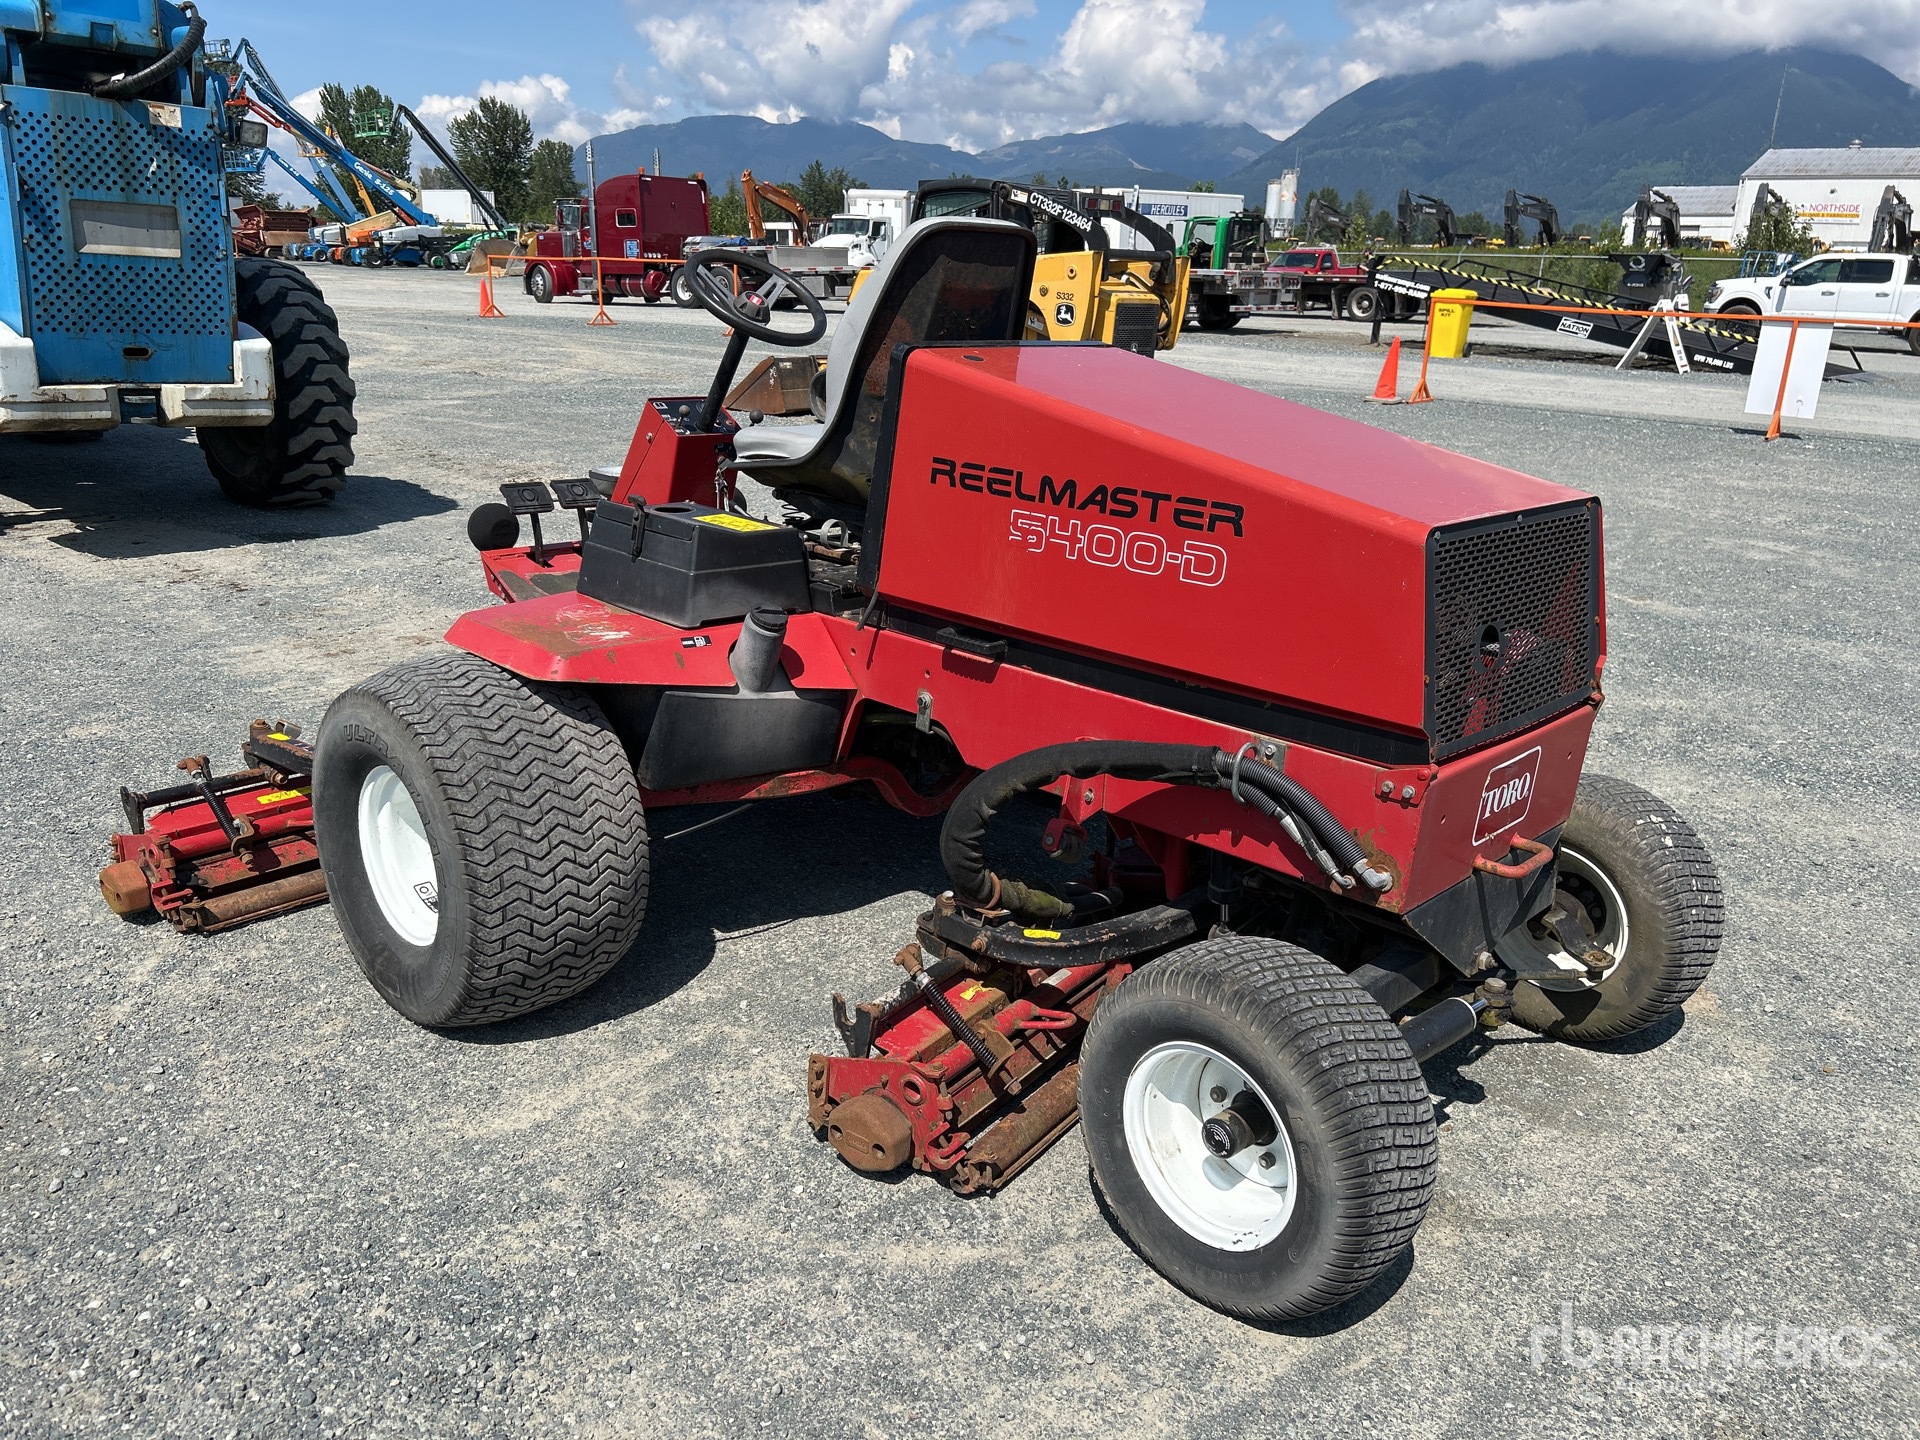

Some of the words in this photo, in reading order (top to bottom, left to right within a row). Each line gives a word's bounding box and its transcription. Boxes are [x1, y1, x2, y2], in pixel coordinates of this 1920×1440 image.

[353, 161, 373, 180] Genie
[374, 178, 396, 196] S-125
[1029, 191, 1093, 233] CT332F123464
[1150, 204, 1186, 216] HERCULES
[1808, 203, 1860, 212] NORTHSIDE
[1055, 291, 1075, 301] S332
[1560, 321, 1590, 334] NATION
[930, 456, 1245, 538] REELMASTER
[1008, 508, 1228, 587] 5400-D
[342, 723, 406, 777] ULTRA
[1481, 772, 1531, 820] TORO
